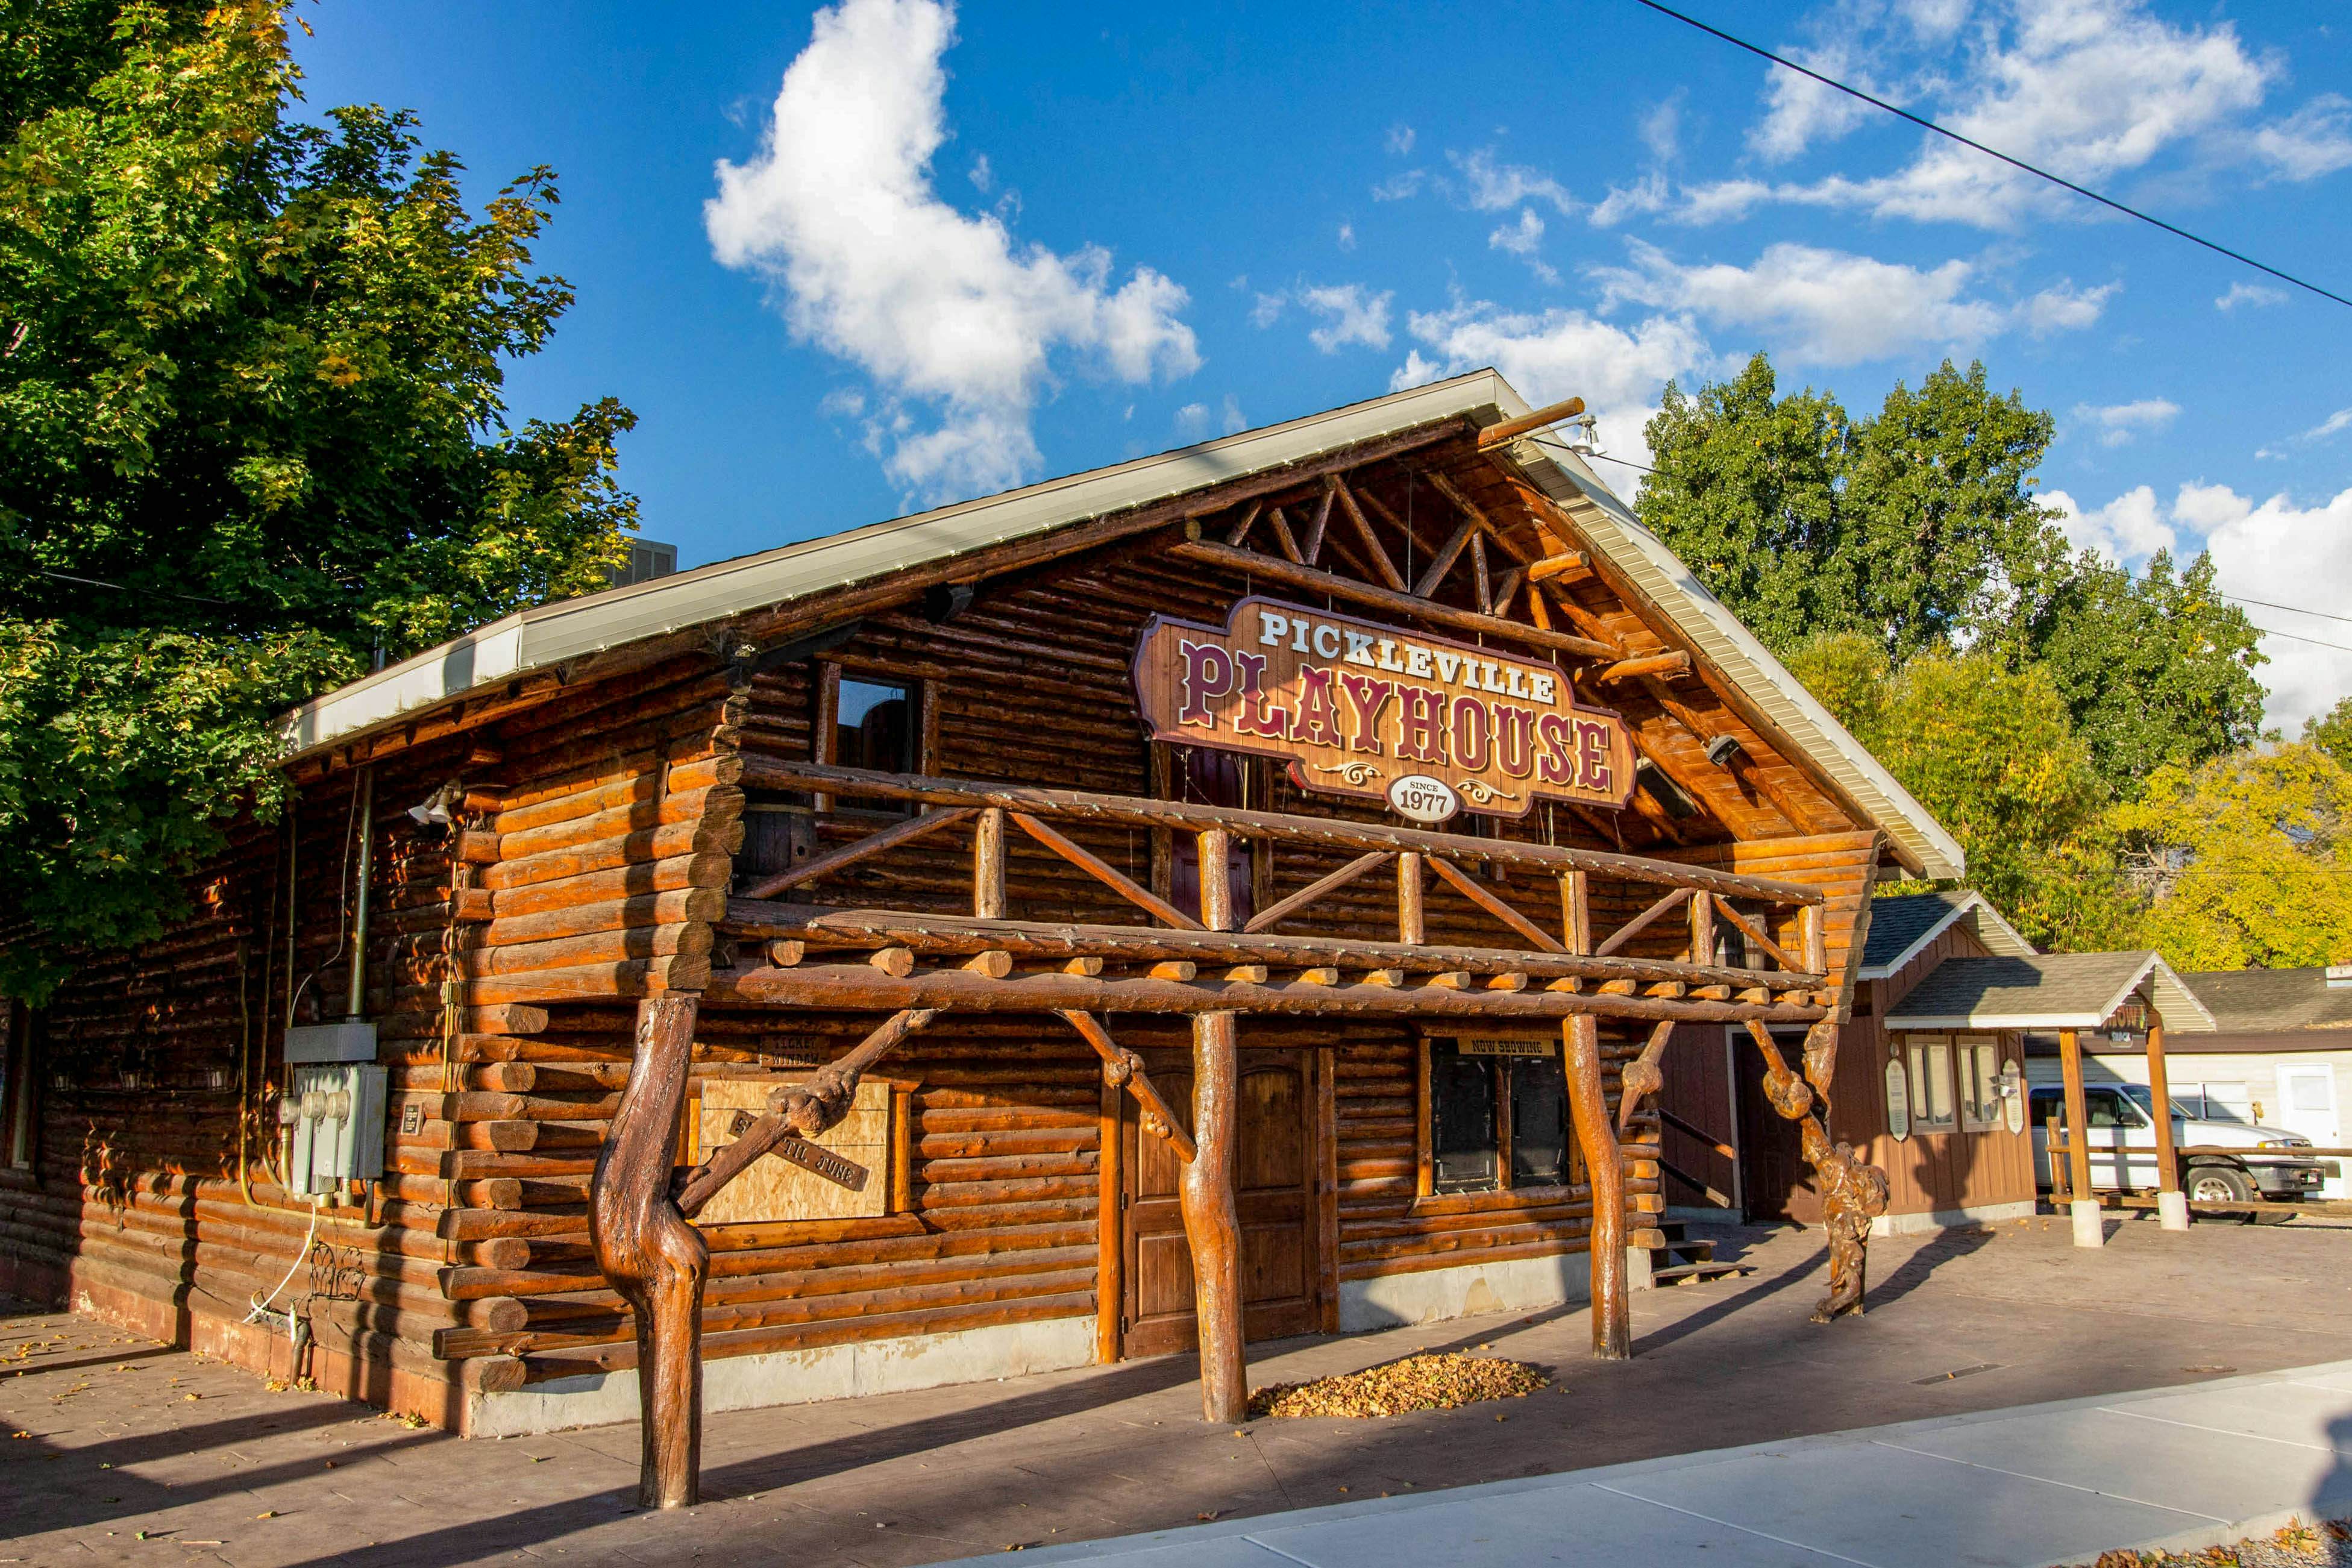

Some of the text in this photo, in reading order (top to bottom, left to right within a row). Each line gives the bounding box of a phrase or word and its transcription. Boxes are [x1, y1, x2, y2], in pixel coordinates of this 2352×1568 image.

[1259, 611, 1555, 705] PICKLEVILLE
[1178, 638, 1611, 793] PLAYHOUSE
[1410, 781, 1438, 792] SINCE
[1400, 790, 1447, 814] 1977
[772, 1052, 820, 1065] WINDOW
[1472, 1040, 1543, 1053] NOW SHOWING
[815, 1155, 855, 1185] JUNE
